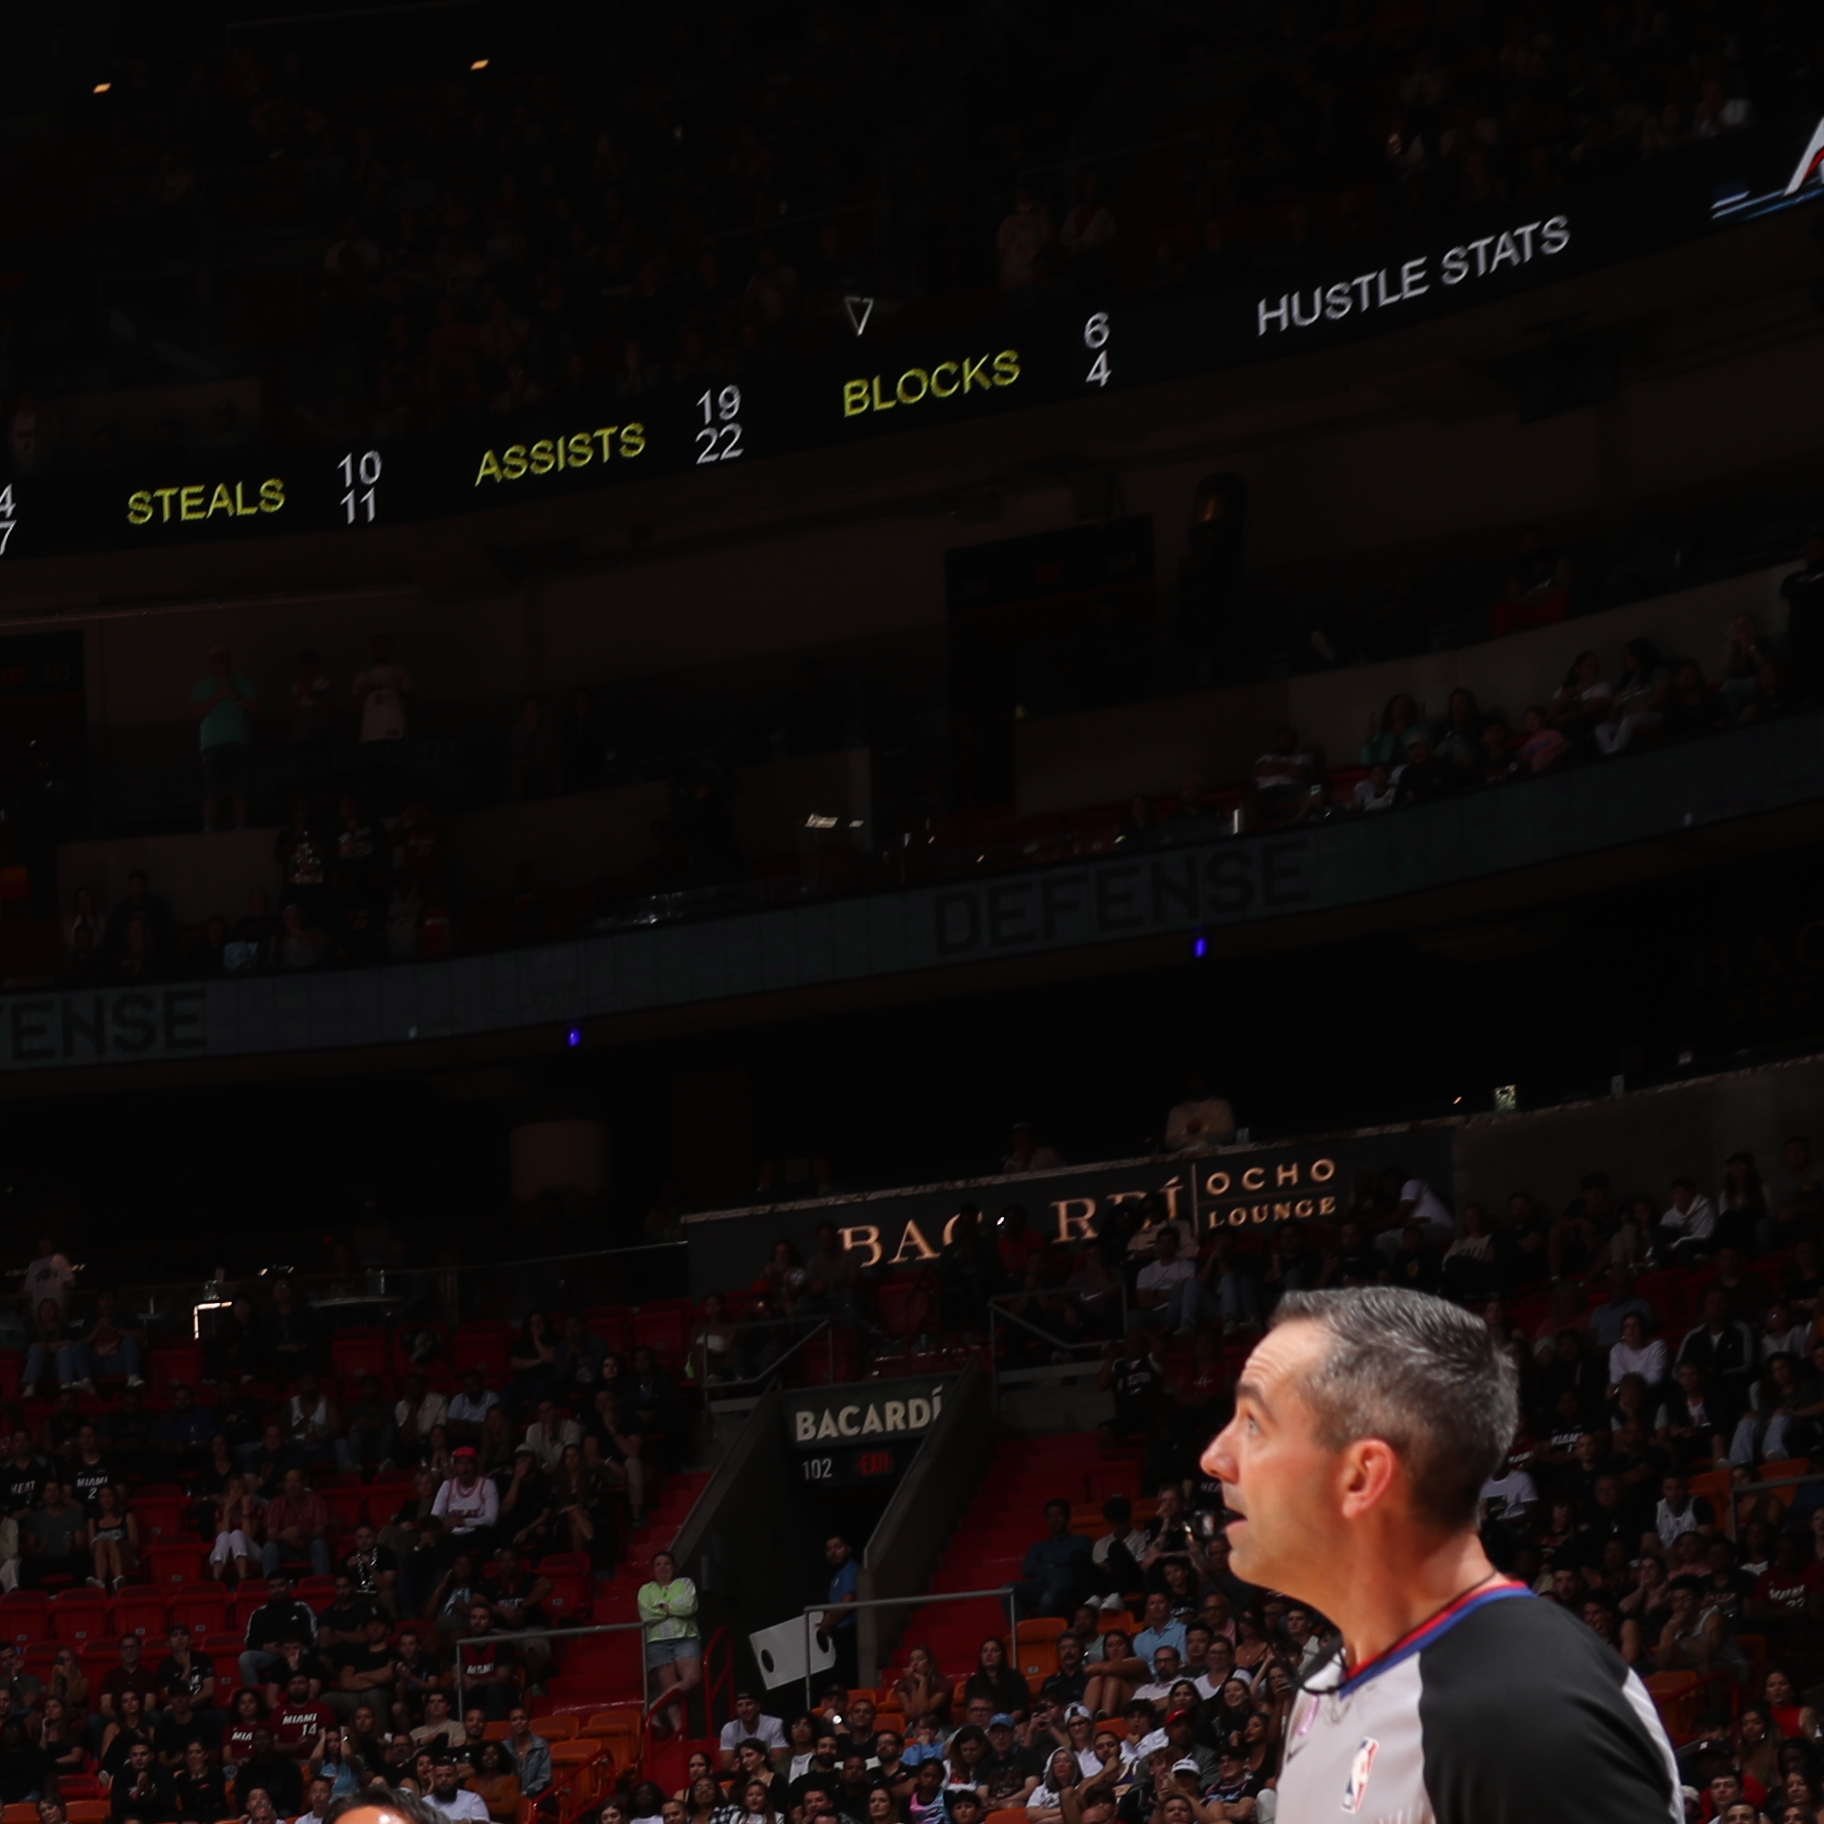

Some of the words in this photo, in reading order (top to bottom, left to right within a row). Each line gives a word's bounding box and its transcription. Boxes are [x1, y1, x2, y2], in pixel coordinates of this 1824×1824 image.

[1257, 256, 1430, 336] HUSTLE
[1441, 216, 1570, 285] STATS
[1085, 312, 1110, 349] 6
[843, 350, 1020, 418] BLOCKS
[1086, 350, 1112, 387] 4
[696, 385, 741, 424] 19
[474, 422, 646, 487] ASSISTS
[695, 424, 743, 465] 22
[337, 450, 382, 488] 10
[127, 478, 285, 525] STEALS
[340, 488, 375, 525] 11
[935, 849, 1313, 954] DEFENSE
[1204, 1157, 1337, 1198] OCHO
[1207, 1194, 1338, 1230] LOUNGE
[795, 1382, 942, 1443] BACARDÍ
[76, 1476, 109, 1487] MIAMI
[801, 1456, 834, 1481] 102
[281, 1712, 318, 1725] MIAMI
[301, 1722, 317, 1737] 14
